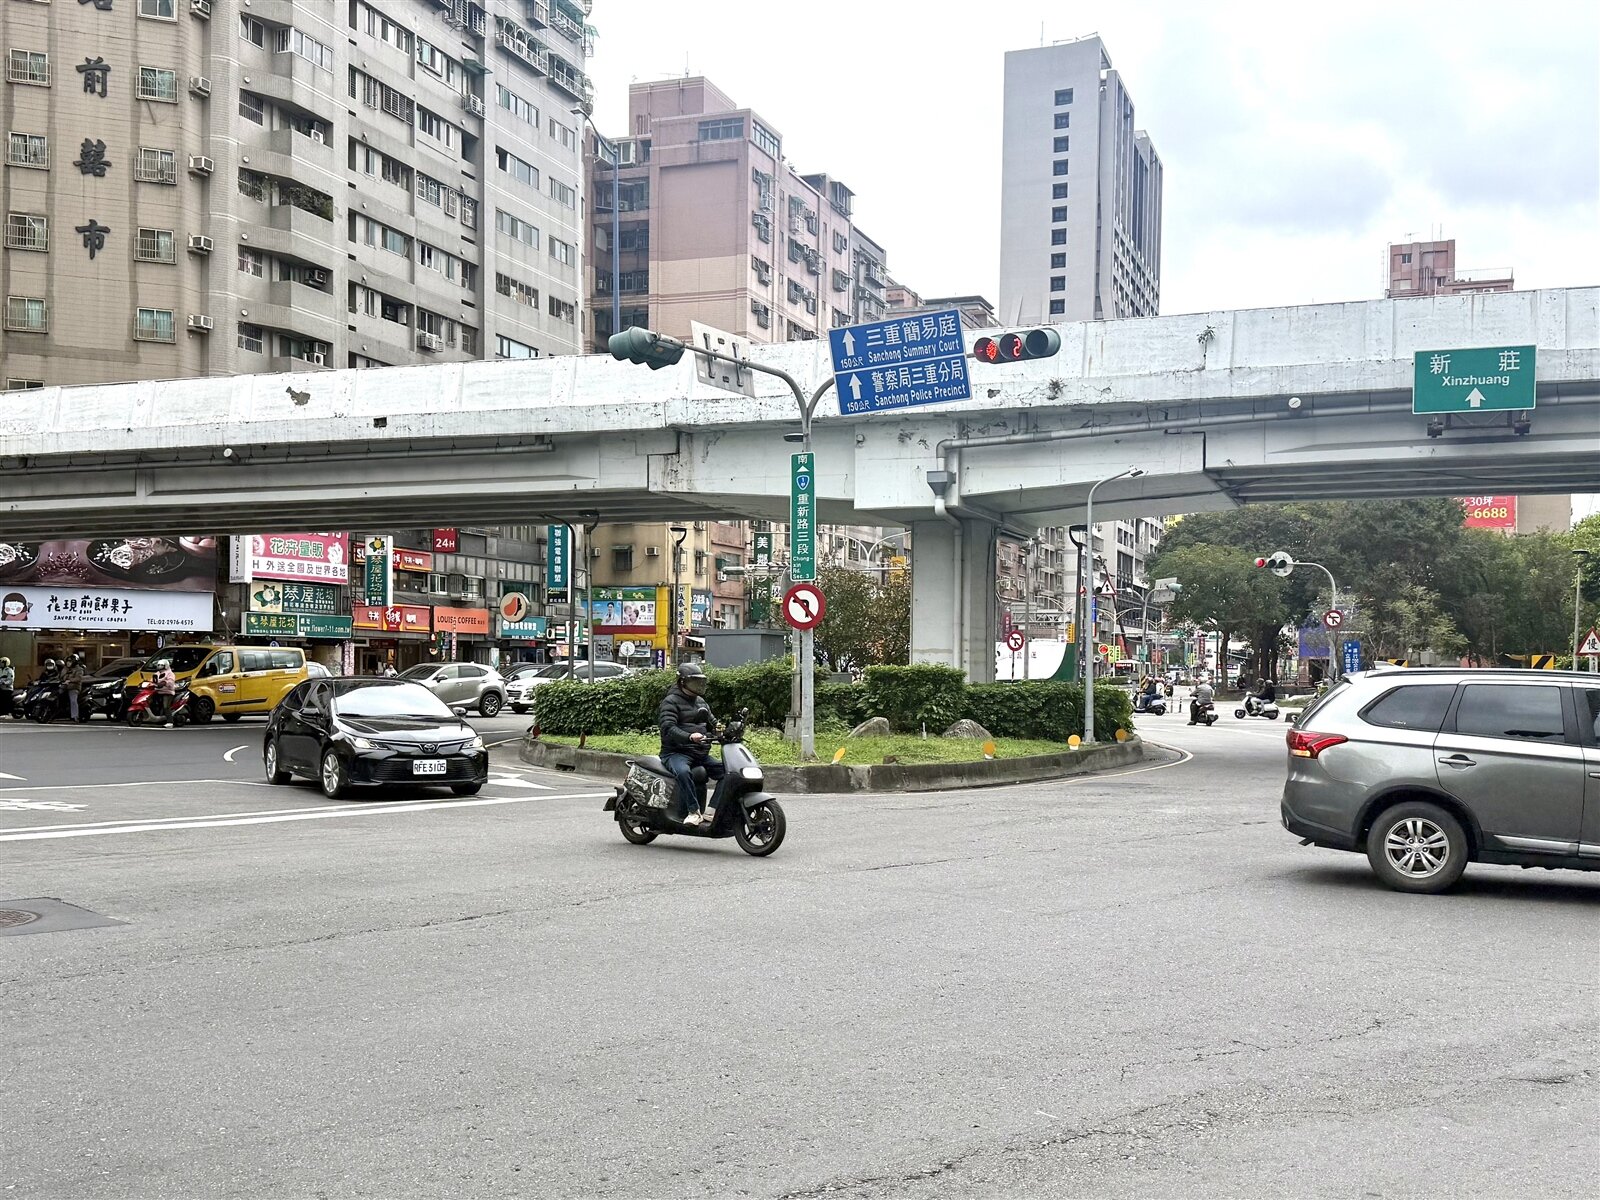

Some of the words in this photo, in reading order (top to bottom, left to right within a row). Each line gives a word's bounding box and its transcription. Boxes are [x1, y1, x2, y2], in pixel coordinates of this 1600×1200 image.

[74, 0, 112, 260] 前囍市
[866, 314, 957, 346] 三重簡易庭
[868, 348, 902, 364] Sanchong
[903, 344, 936, 358] Summary
[938, 338, 960, 352] Court
[840, 356, 864, 368] 150公尺
[871, 360, 964, 392] 警察局三重分局
[1442, 375, 1510, 386] Xinzhuang
[874, 392, 910, 406] Sanchong
[911, 387, 932, 402] Police
[934, 384, 966, 399] Precinct
[847, 400, 870, 412] 150公尺
[797, 454, 808, 464] 南
[797, 493, 810, 555] 重新路三段
[270, 538, 324, 559] 花卉量販
[436, 538, 455, 548] 24H
[266, 560, 346, 577] 外送全國及世界各地
[370, 556, 383, 592] 琴屋花坊
[284, 585, 334, 603] 琴屋花坊
[47, 594, 133, 614] 花現煎餅果子
[260, 616, 295, 628] 琴屋花坊
[300, 625, 350, 633] www.flower7-11.com.tw
[1587, 638, 1598, 650] 慢
